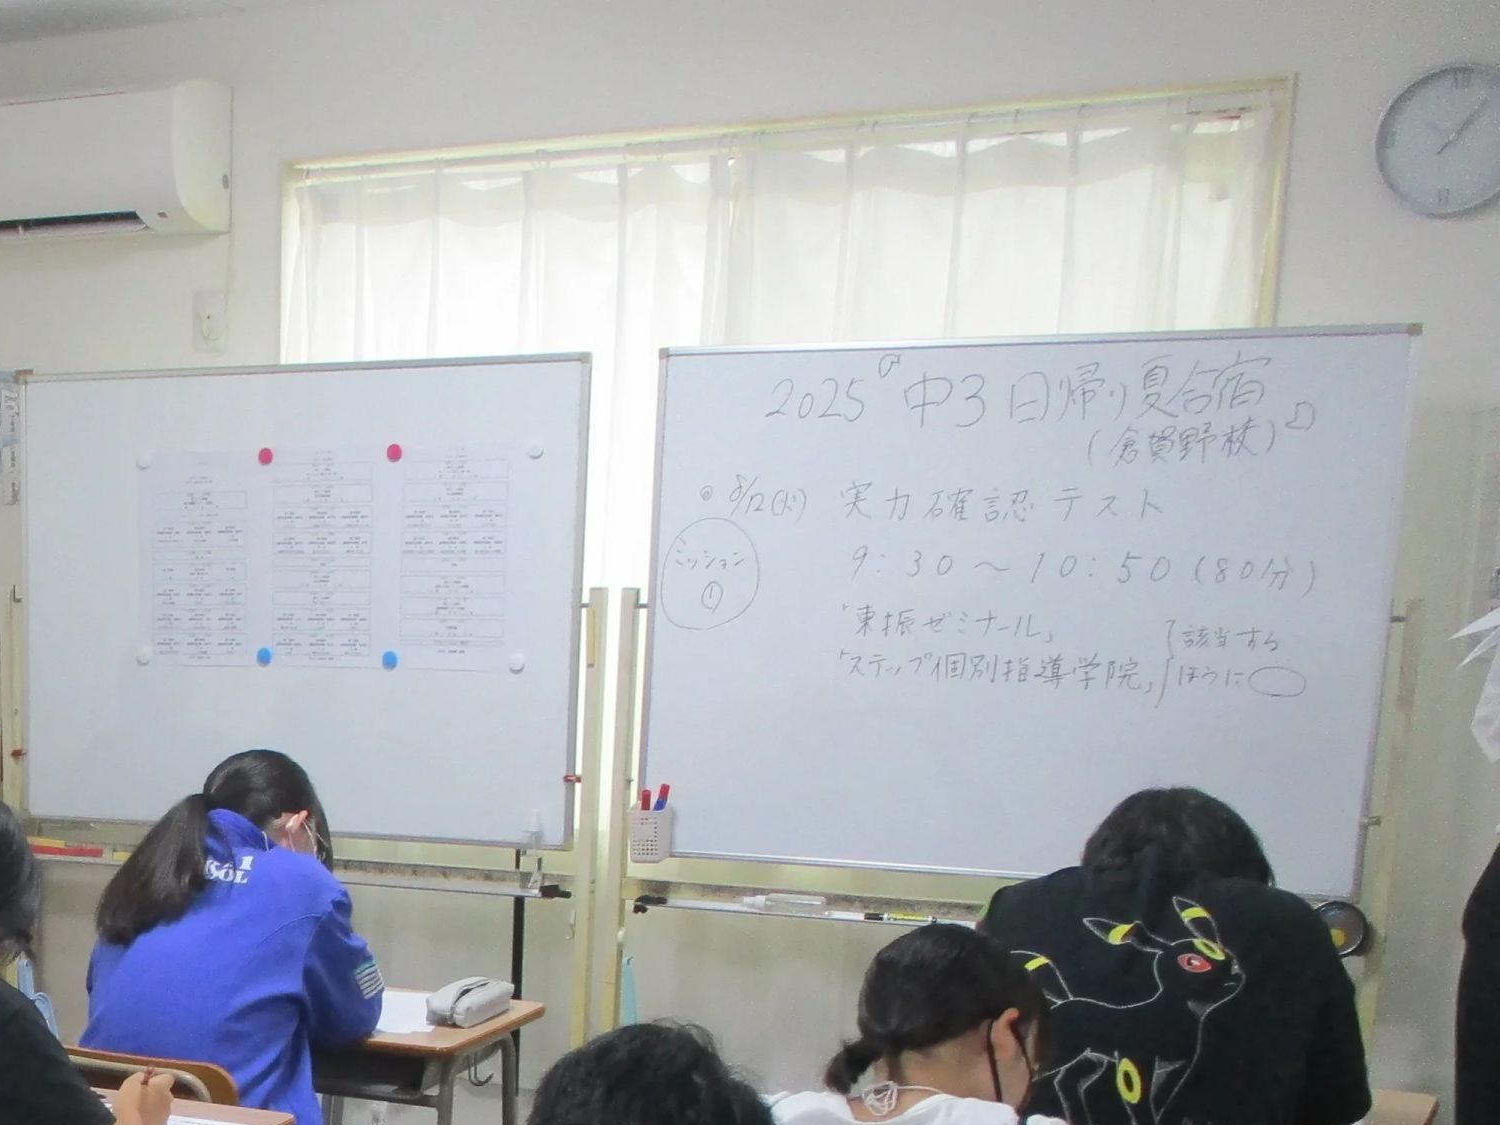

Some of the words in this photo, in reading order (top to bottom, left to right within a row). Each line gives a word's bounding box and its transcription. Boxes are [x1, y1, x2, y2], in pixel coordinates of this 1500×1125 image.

[764, 378, 865, 422] 2025
[839, 481, 1164, 523] 実力確認テスト
[675, 537, 745, 569] ミッション
[1182, 625, 1279, 652] 該当する
